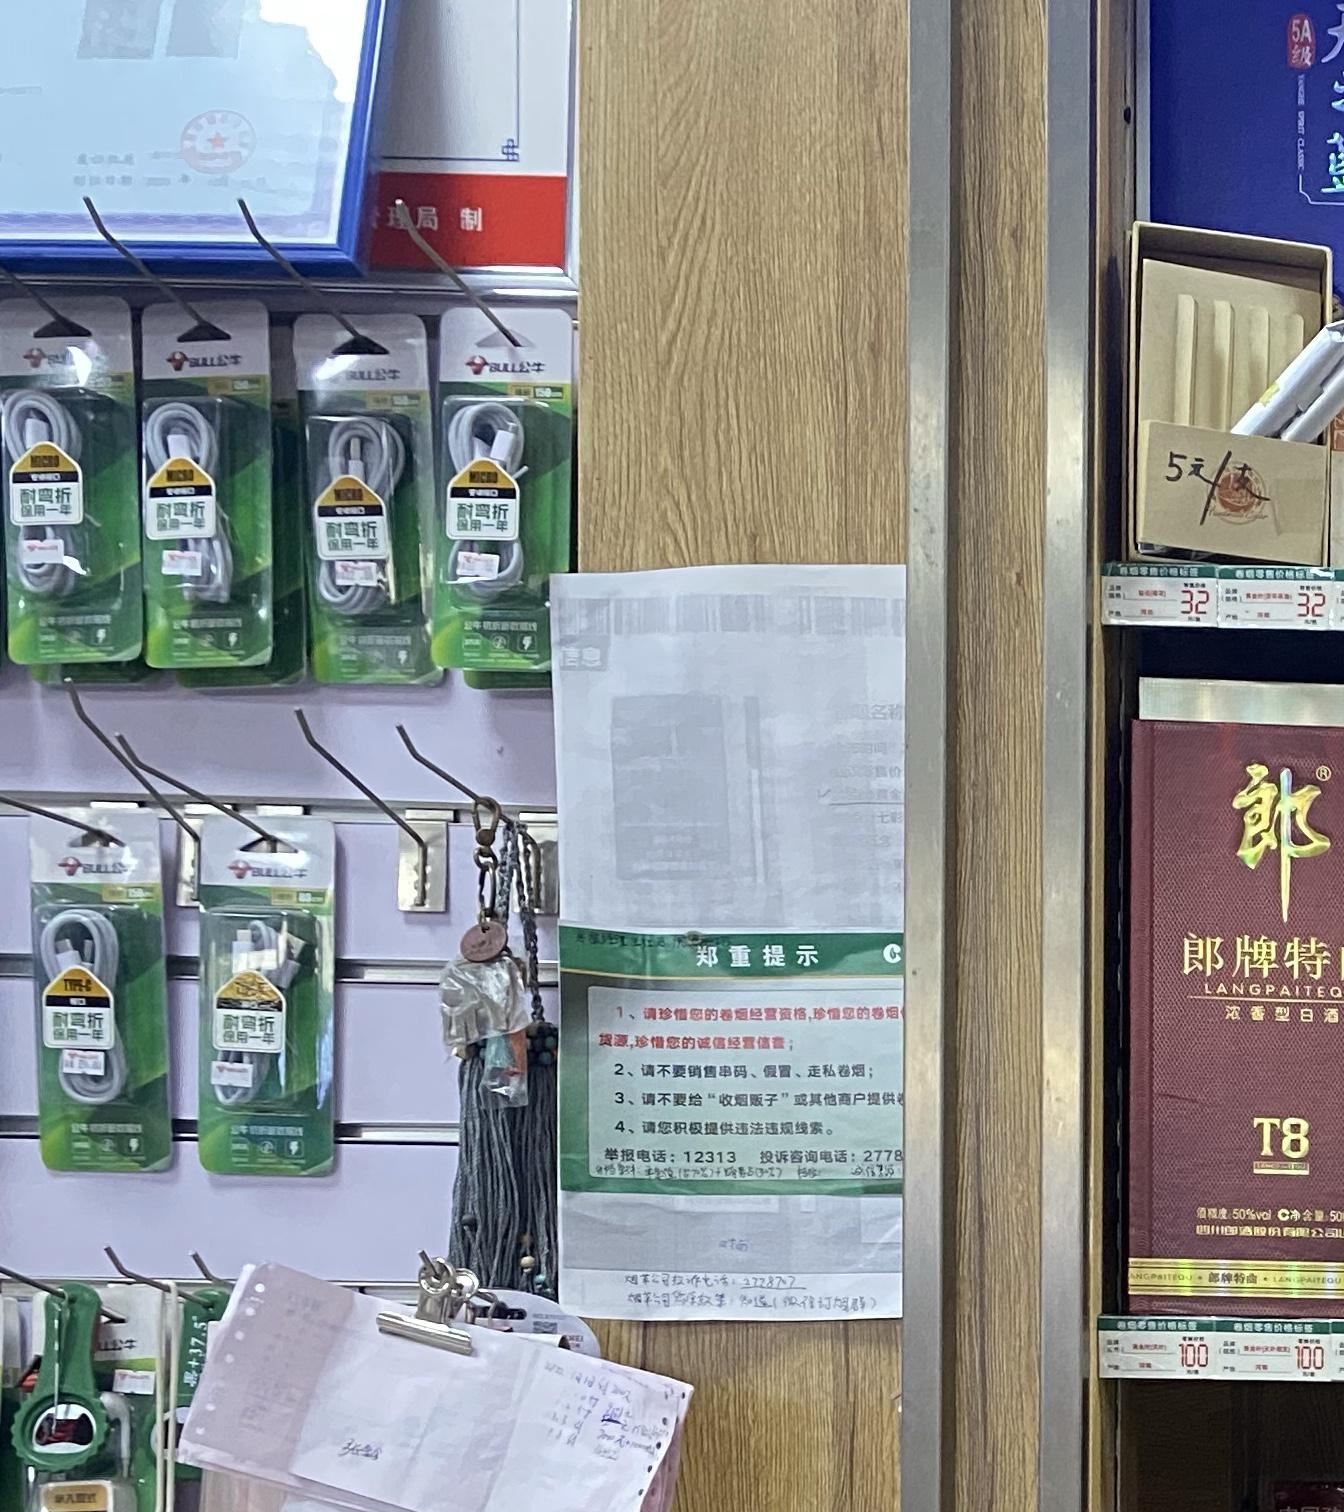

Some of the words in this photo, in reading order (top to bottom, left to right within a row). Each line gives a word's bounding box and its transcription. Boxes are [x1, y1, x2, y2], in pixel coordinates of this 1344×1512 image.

[371, 206, 439, 231] 理局
[460, 207, 484, 231] 制
[20, 487, 72, 504] 耐弯折
[156, 501, 206, 518] 耐弯折
[326, 521, 378, 540] 耐弯折
[1181, 590, 1208, 615] 32
[1298, 593, 1326, 618] 32
[1232, 762, 1332, 924] 郎
[697, 944, 820, 968] 郑重提示
[1224, 1004, 1340, 1024] 浓香型白酒
[1253, 1116, 1311, 1159] T8
[1179, 1343, 1209, 1368] 100
[1295, 1346, 1324, 1370] 100
